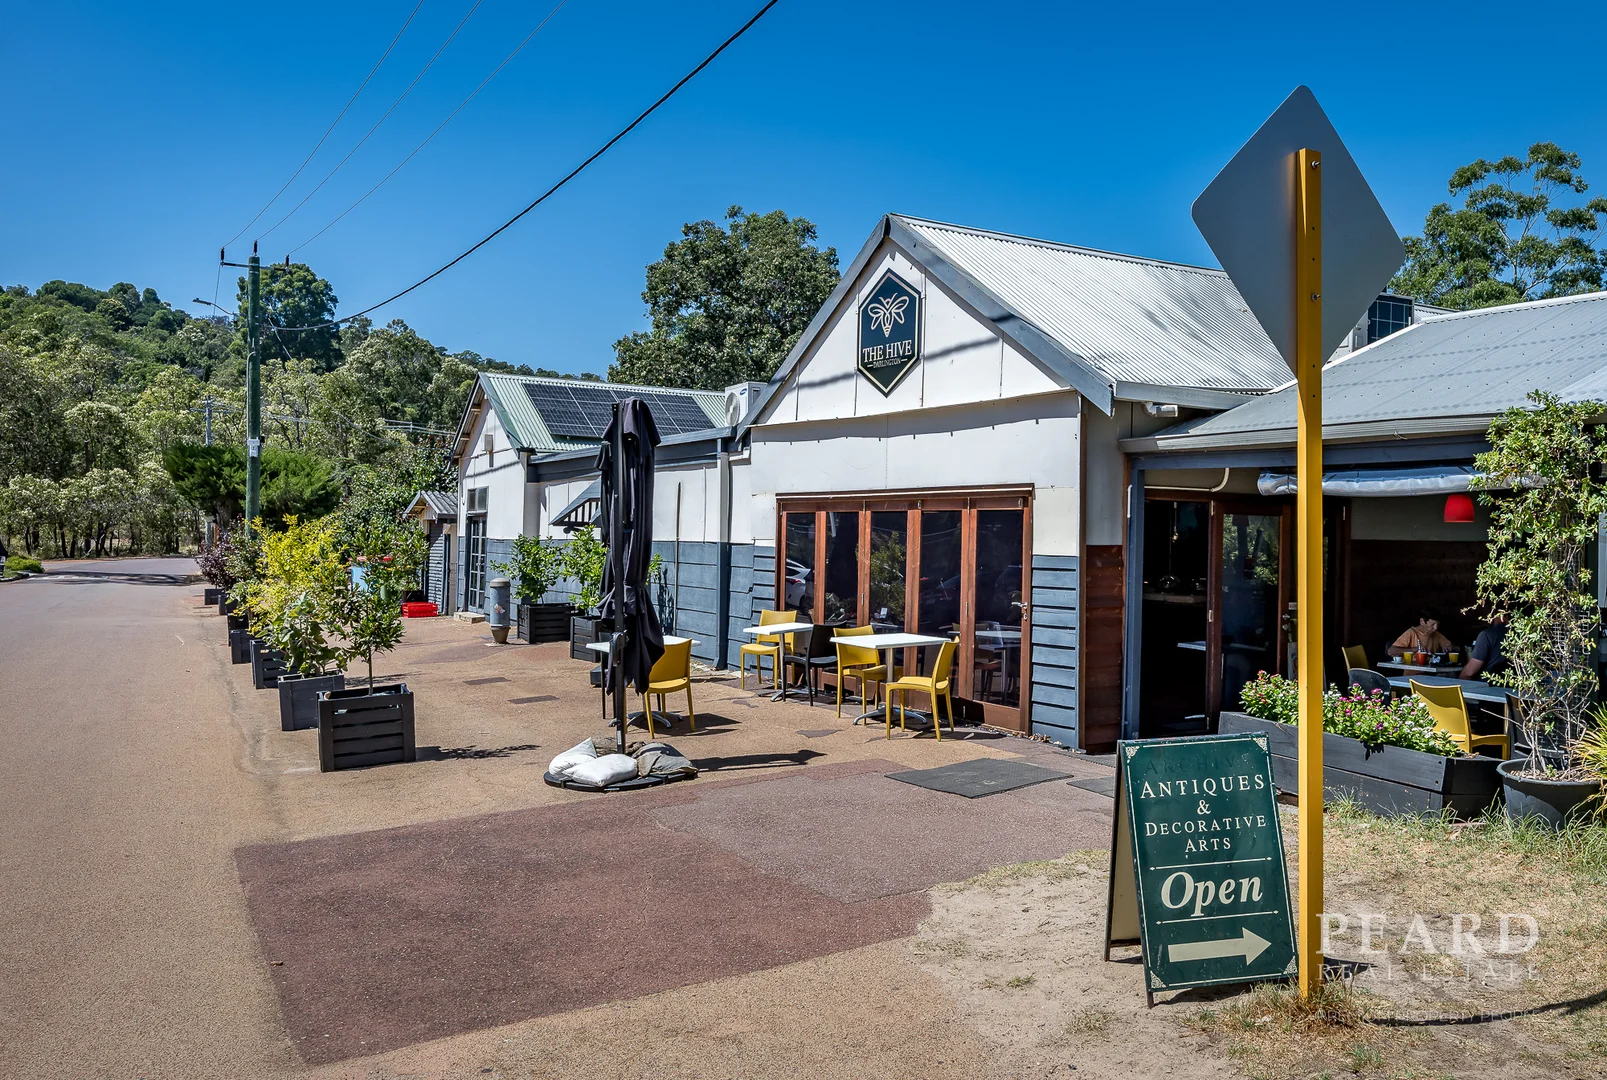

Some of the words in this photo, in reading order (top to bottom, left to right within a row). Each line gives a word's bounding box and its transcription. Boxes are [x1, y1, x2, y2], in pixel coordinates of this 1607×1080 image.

[863, 345, 884, 363] THE
[886, 339, 912, 359] HIVE
[873, 358, 902, 369] DARLINGTON
[1140, 774, 1265, 799] ANTIQUES
[1196, 799, 1212, 815] &
[1144, 815, 1267, 837] DECORATIVE
[1184, 837, 1231, 853] ARTS
[1160, 871, 1263, 917] Open
